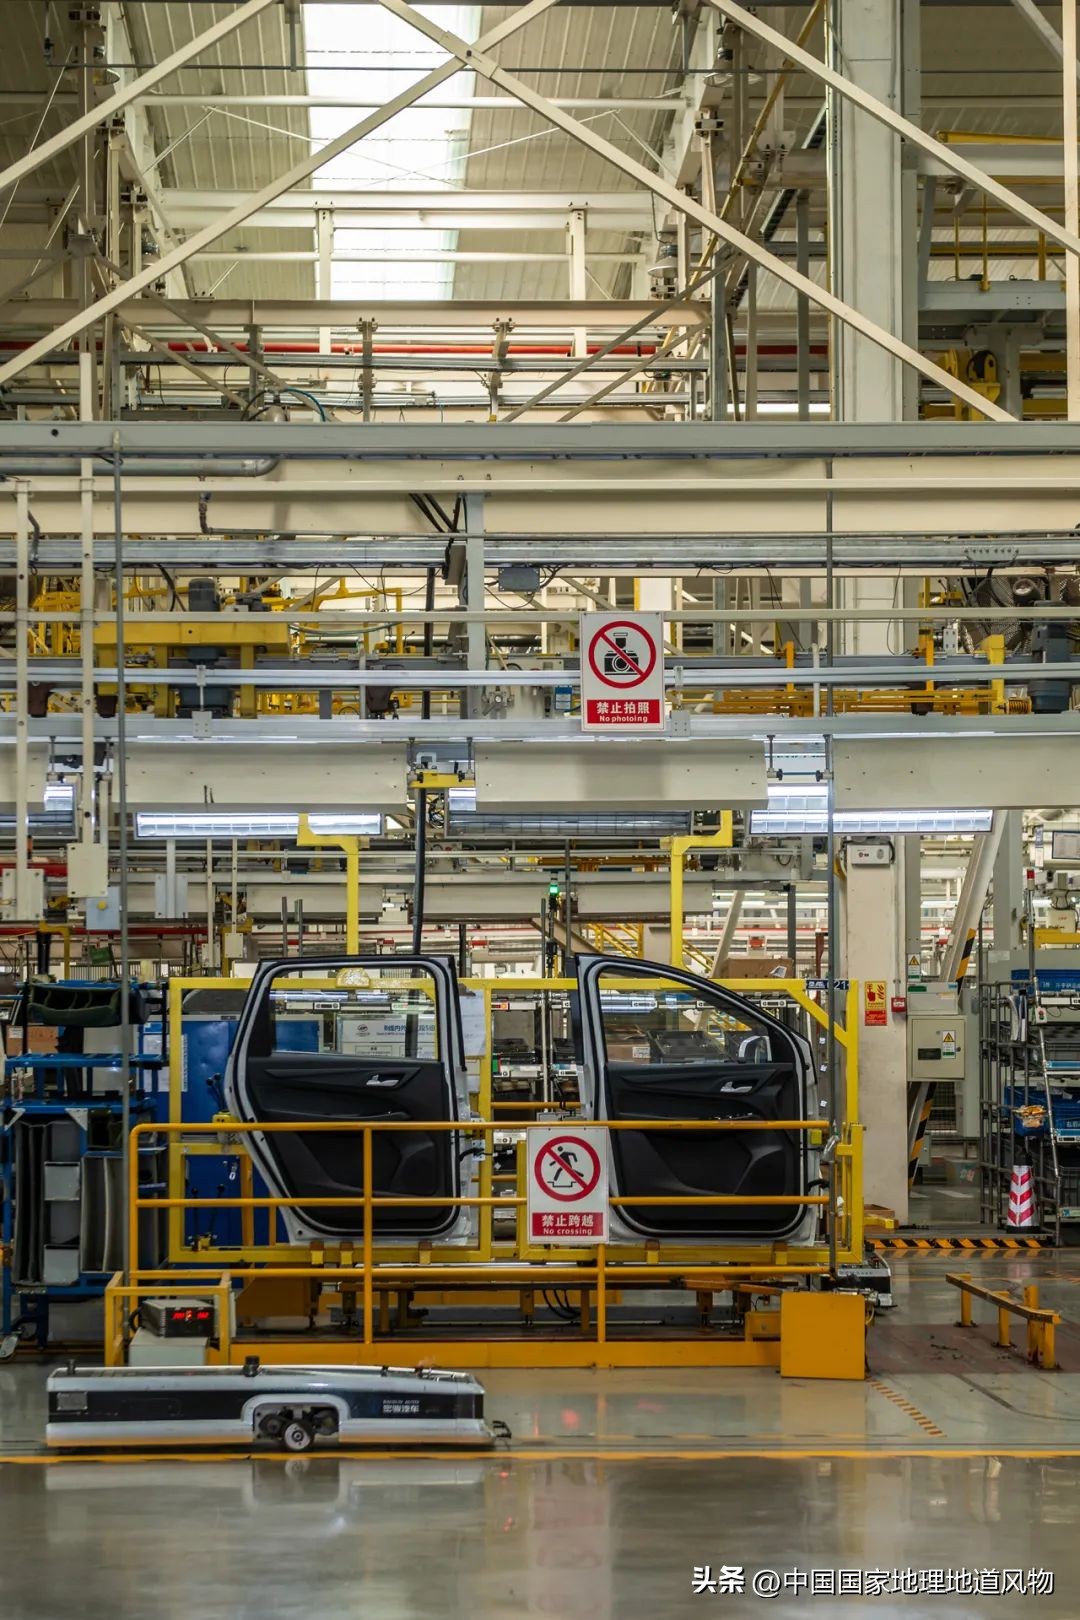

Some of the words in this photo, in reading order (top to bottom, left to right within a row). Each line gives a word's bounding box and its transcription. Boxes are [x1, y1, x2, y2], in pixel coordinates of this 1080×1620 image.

[597, 702, 650, 714] 禁止拍照
[612, 715, 648, 723] photoing
[542, 1215, 594, 1227] 禁止跨越
[557, 1228, 592, 1236] crossing
